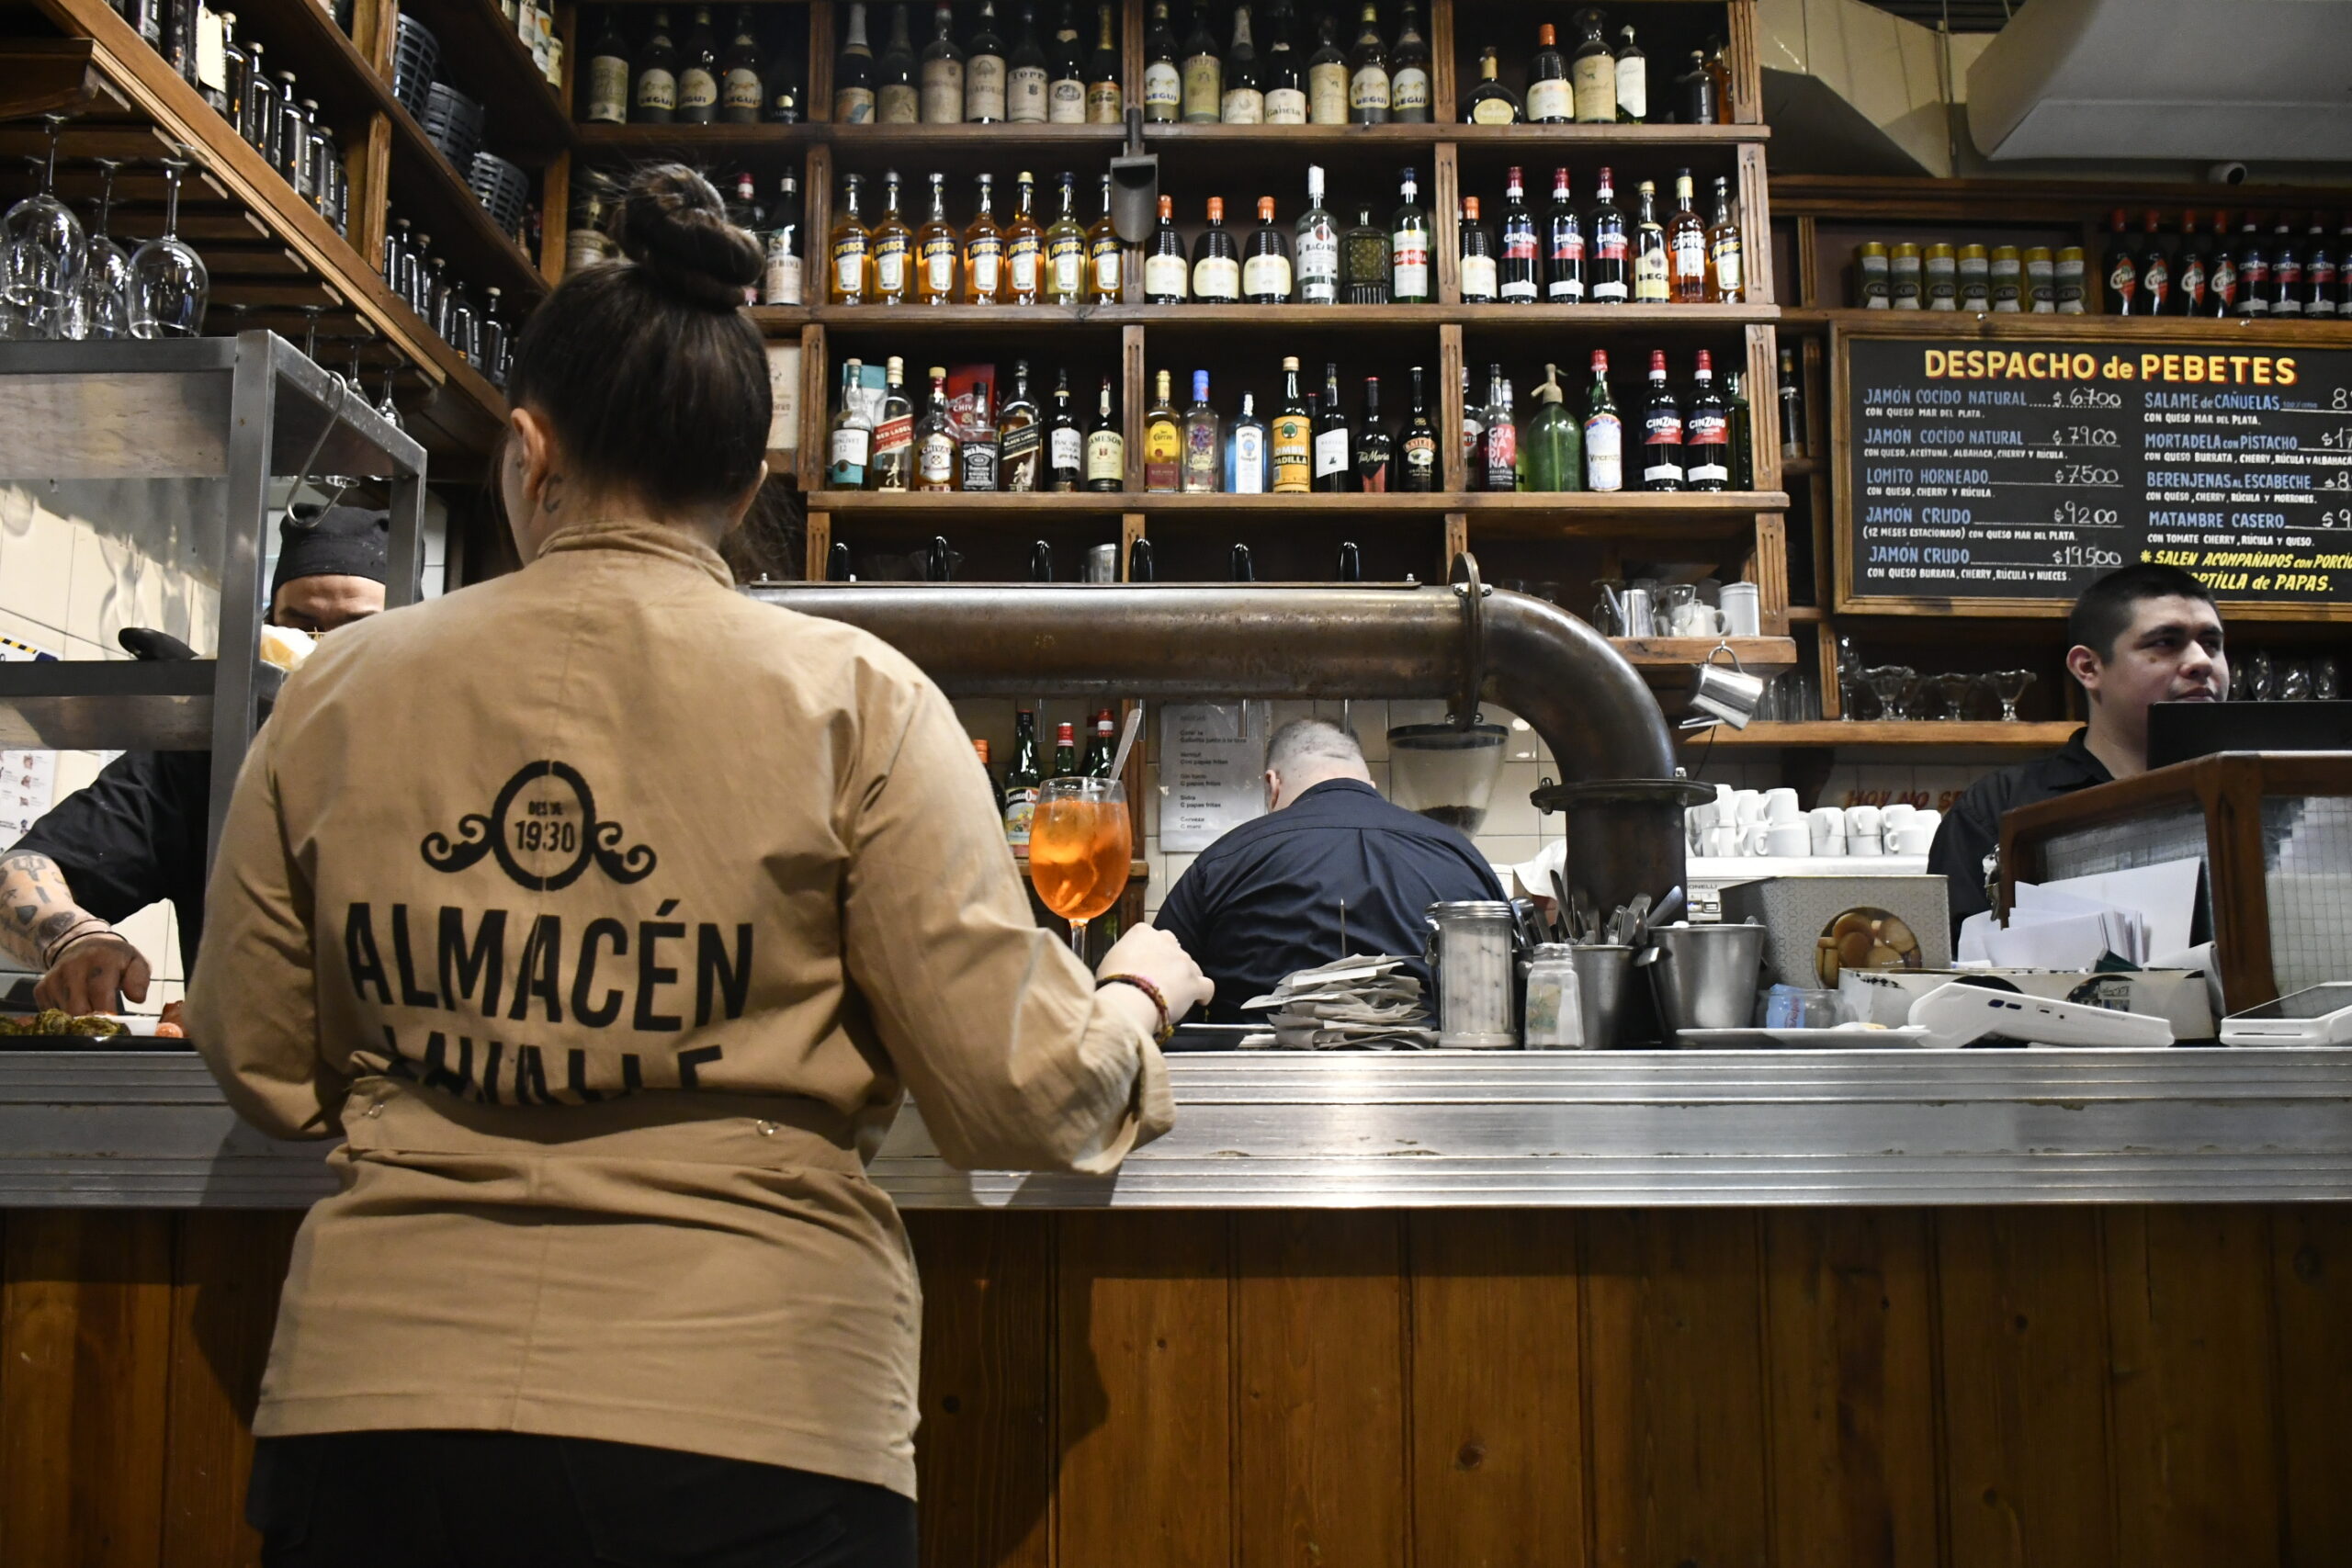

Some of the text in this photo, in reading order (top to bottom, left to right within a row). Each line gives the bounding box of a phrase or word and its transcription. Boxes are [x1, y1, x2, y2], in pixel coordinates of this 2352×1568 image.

[835, 241, 865, 256] APEROL
[876, 240, 905, 255] APEROL
[924, 241, 955, 256] APEROL
[970, 242, 1001, 256] APEROL
[1009, 240, 1039, 256] APEROL
[1052, 241, 1082, 257] APEROL
[1925, 349, 2297, 386] DESPACHO de PEBETES
[1863, 385, 1911, 406] JAMÓN
[1968, 389, 2027, 406] NATURAL
[2144, 391, 2199, 410] SALAME
[2200, 396, 2213, 409] de
[2214, 390, 2280, 411] CAÑUELAS
[1865, 407, 1883, 417] CON
[1886, 407, 1914, 419] QUESO
[1918, 407, 1938, 418] MAR
[1939, 409, 1953, 418] DEL
[2144, 412, 2161, 423] CON
[2165, 412, 2191, 424] QUESO
[2194, 413, 2213, 424] MAR
[2216, 415, 2230, 425] DEL
[1645, 415, 1681, 430] CINZANO
[1689, 415, 1726, 430] CINZANO
[876, 424, 912, 441] RED LABEL
[1487, 426, 1513, 438] GRA
[1864, 423, 1911, 445] JAMÓN
[1969, 429, 2024, 446] NATURAL
[1488, 438, 1508, 449] NA
[2144, 434, 2220, 450] MORTADELA
[2240, 432, 2297, 451] PISTACHO
[1274, 445, 1306, 456] OMBU
[1488, 447, 1501, 458] DI
[1864, 447, 1880, 458] CON
[1997, 448, 2026, 458] CHERRY
[2028, 449, 2034, 458] Y
[2144, 451, 2161, 462] CON
[2164, 451, 2191, 463] QUESO
[1488, 458, 1509, 469] NA
[1866, 466, 1914, 485] LOMITO
[1920, 468, 1988, 485] HORNEADO
[2146, 471, 2312, 491] BERENJENAS AL ESCABECHE
[1867, 486, 1883, 497] CON
[1917, 487, 1948, 497] CHERRY
[1951, 488, 1958, 497] Y
[2145, 491, 2161, 502] CON
[2231, 491, 2260, 502] RÚCULA
[2264, 493, 2270, 502] Y
[1865, 502, 1913, 525] JAMÓN
[1922, 507, 1971, 525] CRUDO
[2148, 511, 2285, 529] MATAMBRE CASERO
[1880, 526, 1907, 538] MESES
[1969, 530, 1984, 539] CON
[1986, 529, 2012, 540] QUESO
[2014, 530, 2031, 540] MAR
[2033, 531, 2047, 540] DEL
[2147, 533, 2165, 544] CON
[2166, 534, 2199, 545] TOMATE
[2241, 533, 2274, 547] RÚCULA
[2277, 536, 2283, 545] Y
[1869, 542, 1918, 564] JAMÓN
[1923, 547, 1970, 564] CRUDO
[2154, 549, 2199, 568] SALEN
[2203, 550, 2293, 570] ACOMPAÑADOS
[1867, 567, 1884, 579] CON
[1888, 568, 1917, 580] QUESO
[1996, 567, 2027, 581] RÚCULA
[2252, 573, 2271, 591] de
[2274, 573, 2334, 592] PAPAS.
[527, 800, 563, 817] DESDE
[514, 819, 576, 852] 1930
[345, 898, 753, 1032] ALMACÉN
